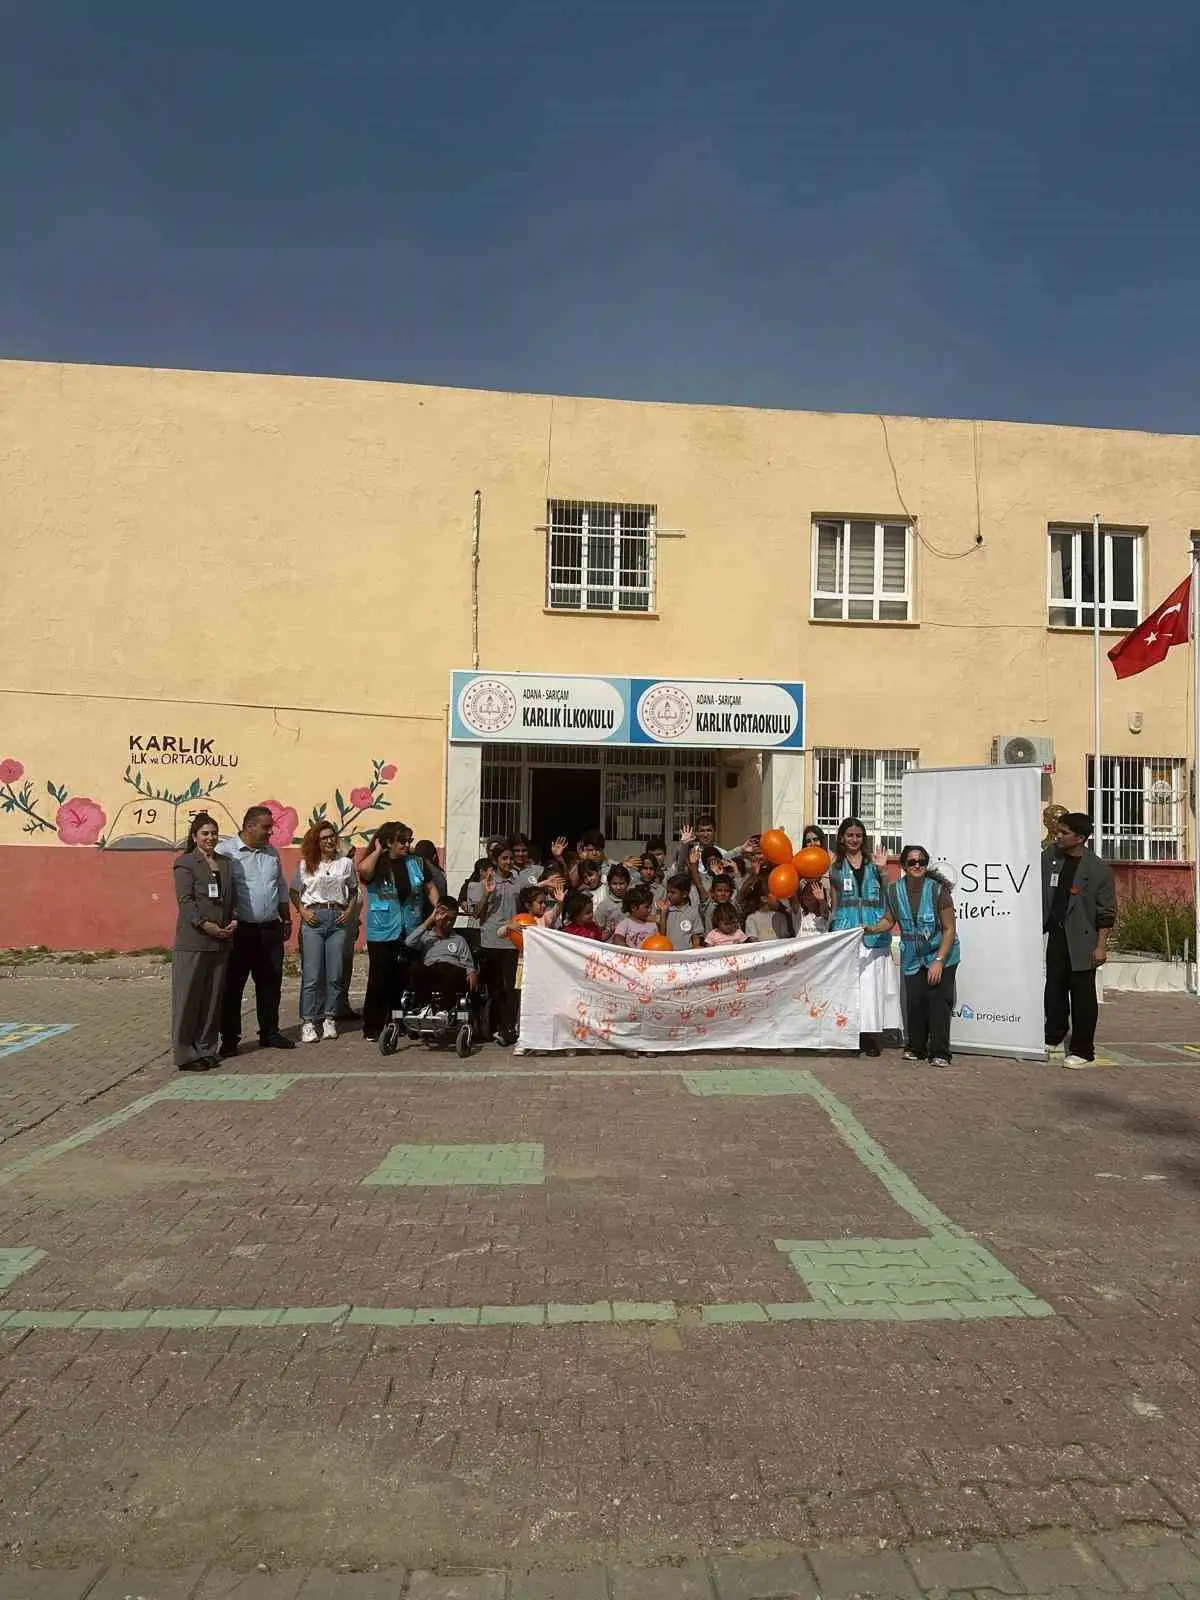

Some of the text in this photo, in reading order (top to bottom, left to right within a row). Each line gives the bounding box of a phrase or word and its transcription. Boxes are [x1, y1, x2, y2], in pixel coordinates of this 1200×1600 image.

[523, 689, 541, 700] ADANA
[546, 690, 569, 702] SARIÇAM
[696, 694, 714, 705] ADANA
[718, 695, 741, 708] SARIÇAM
[523, 704, 614, 729] KARLIK İLKOKULU
[696, 712, 732, 732] KARLIK
[734, 713, 791, 734] ORTAOKULU
[129, 735, 215, 754] KARLIK
[161, 753, 239, 767] ORTAOKULU
[133, 808, 157, 825] 19
[953, 900, 1011, 920] ileri...
